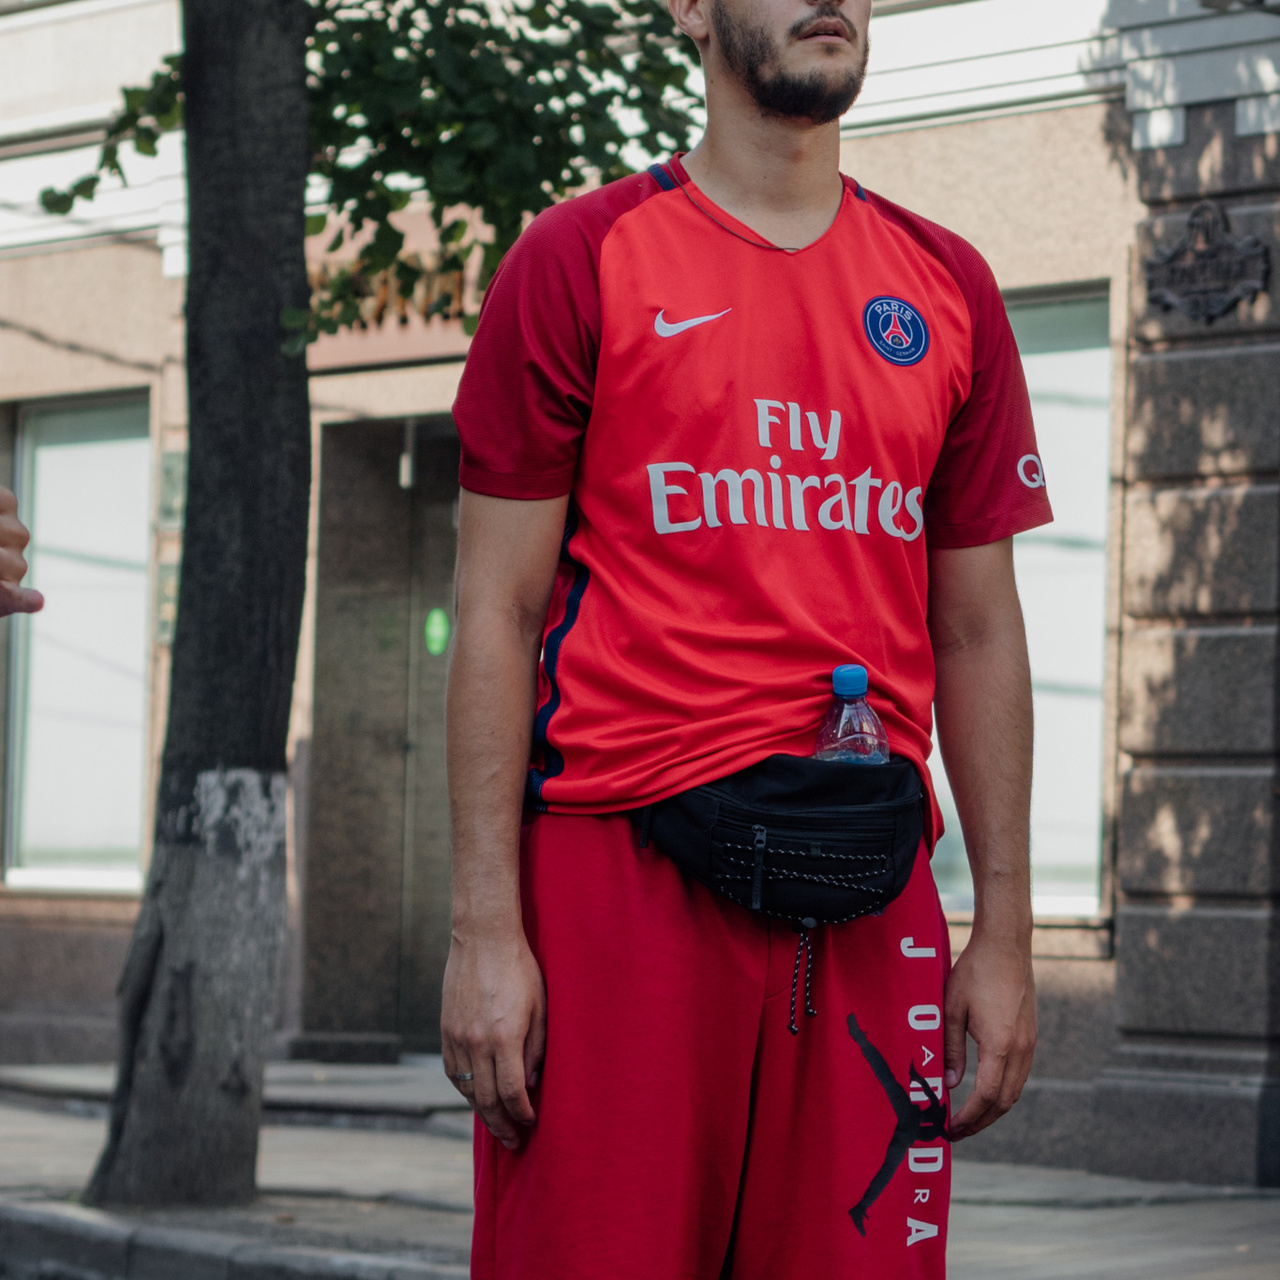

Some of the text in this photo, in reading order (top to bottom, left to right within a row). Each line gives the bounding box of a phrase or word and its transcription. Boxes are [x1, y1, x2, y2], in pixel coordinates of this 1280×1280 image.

[874, 302, 913, 321] PARIS
[753, 399, 842, 461] Fly
[647, 454, 924, 542] Emirates
